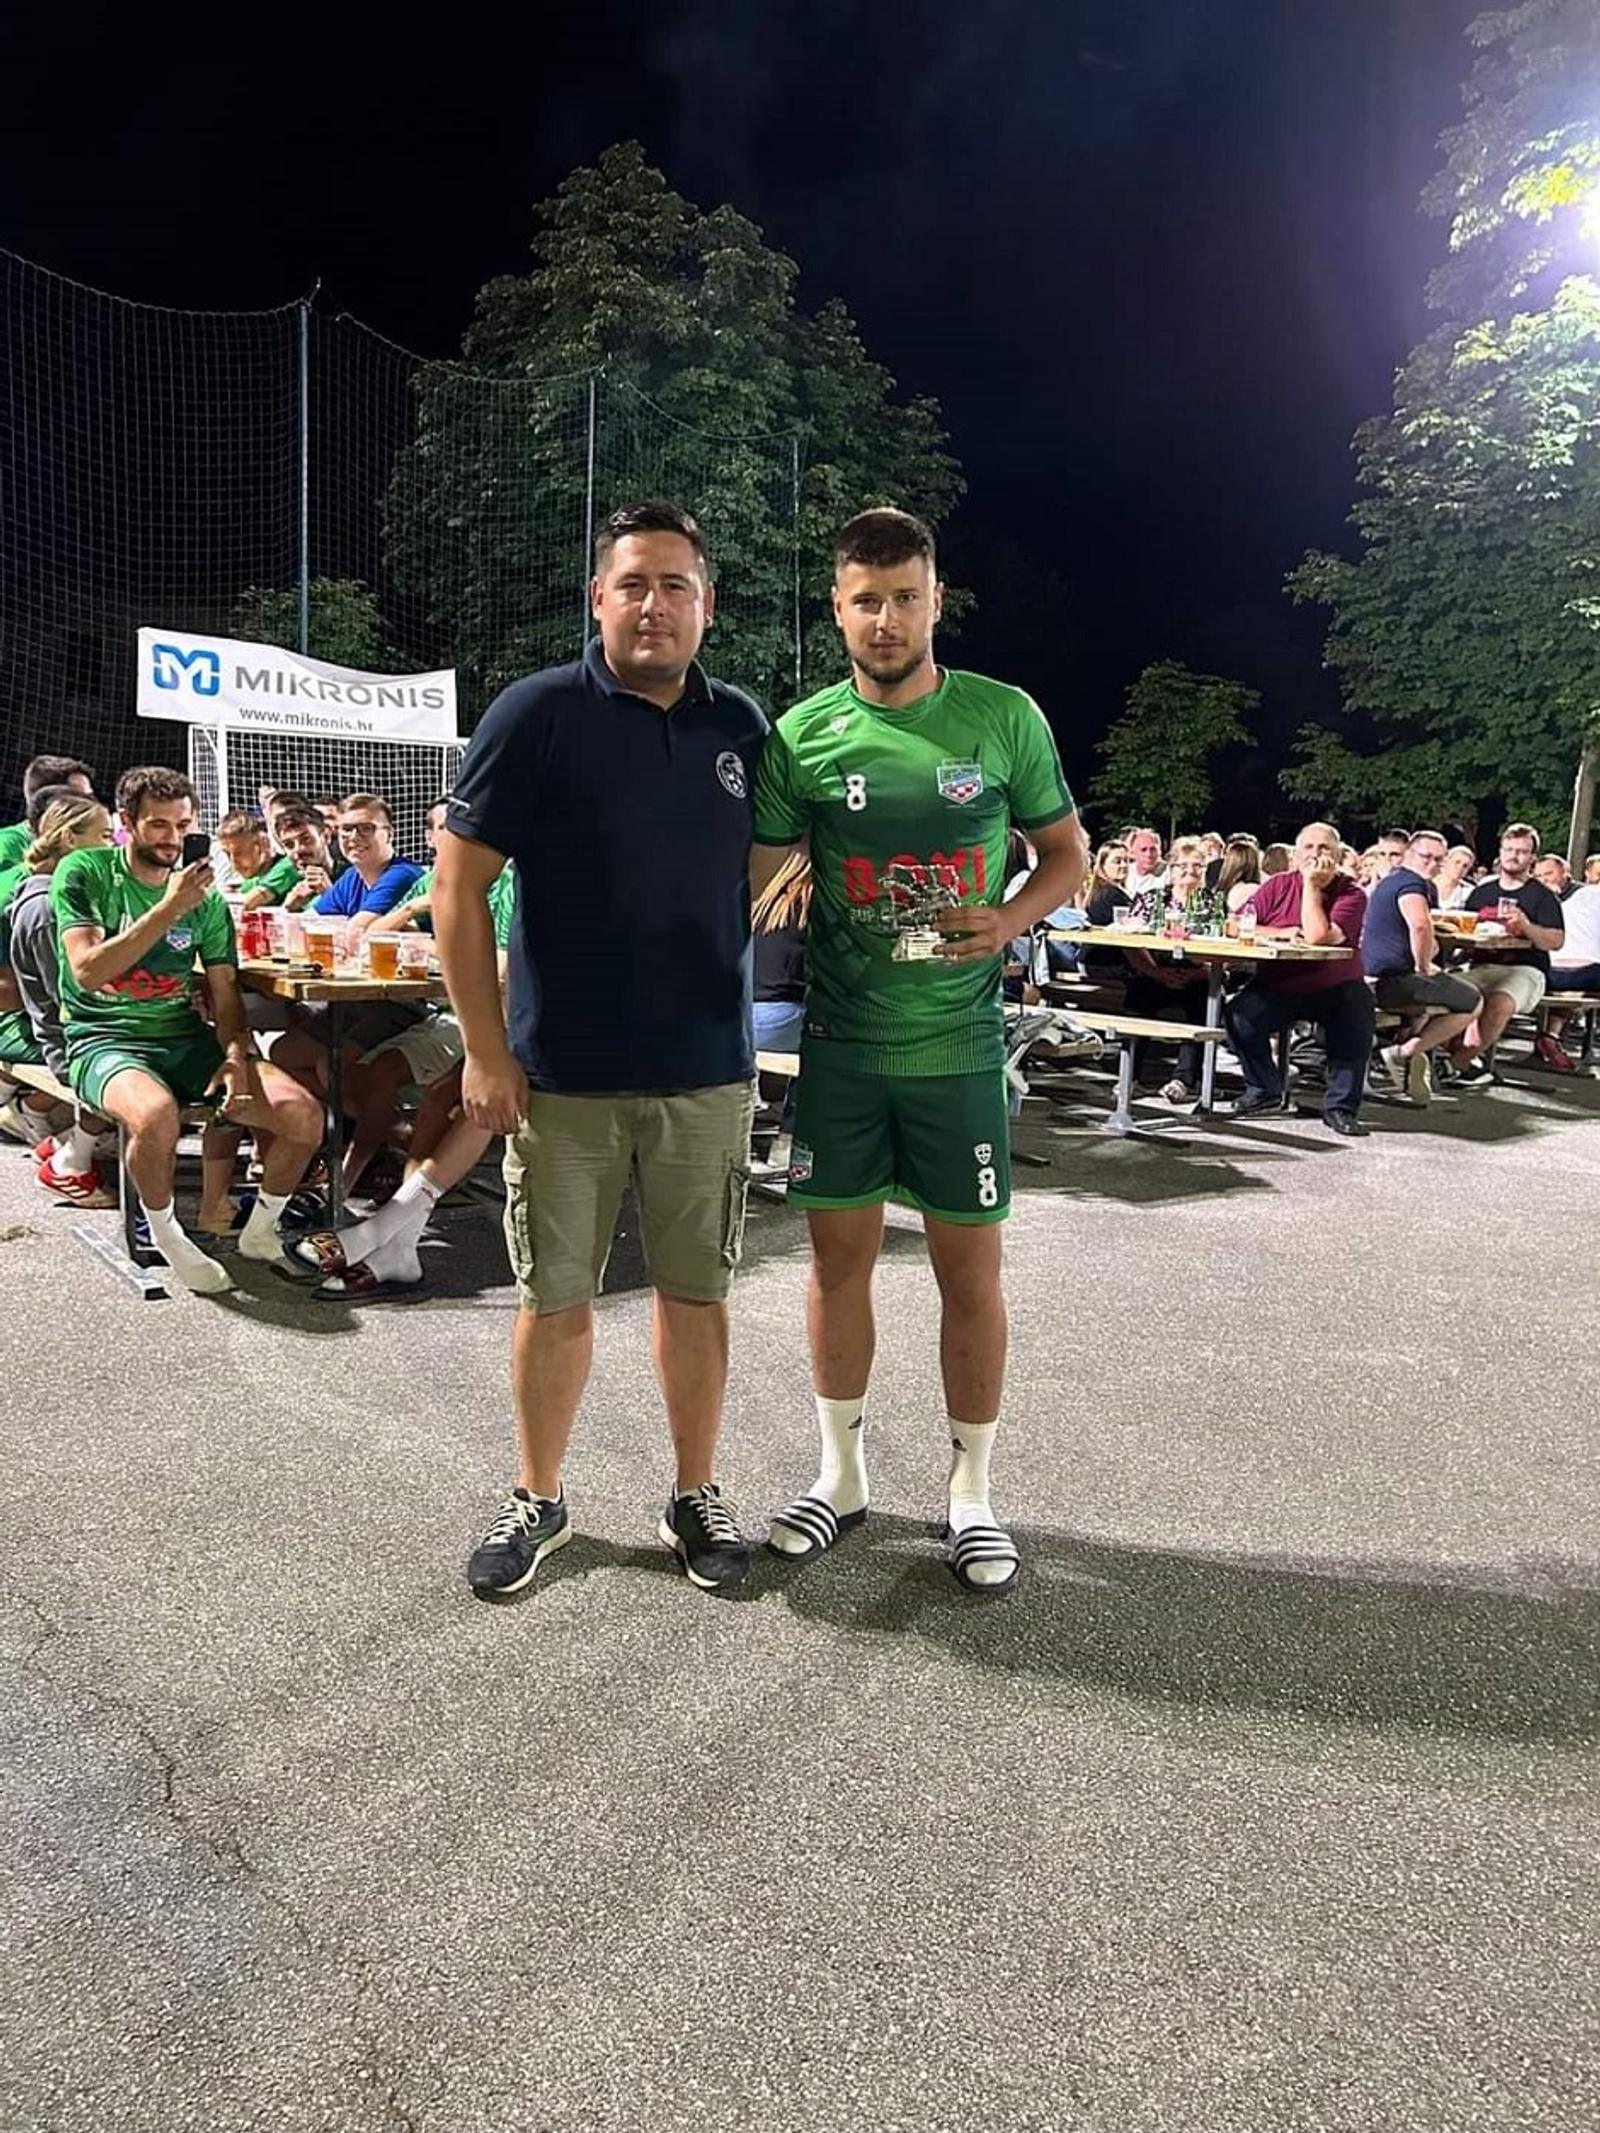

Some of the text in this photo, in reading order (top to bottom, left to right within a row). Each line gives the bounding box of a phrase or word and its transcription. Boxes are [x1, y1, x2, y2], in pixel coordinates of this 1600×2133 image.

[235, 665, 445, 710] MIKRONIS
[238, 707, 374, 732] www.mikronis.hr
[846, 774, 867, 811] 8
[977, 1166, 998, 1207] 8
